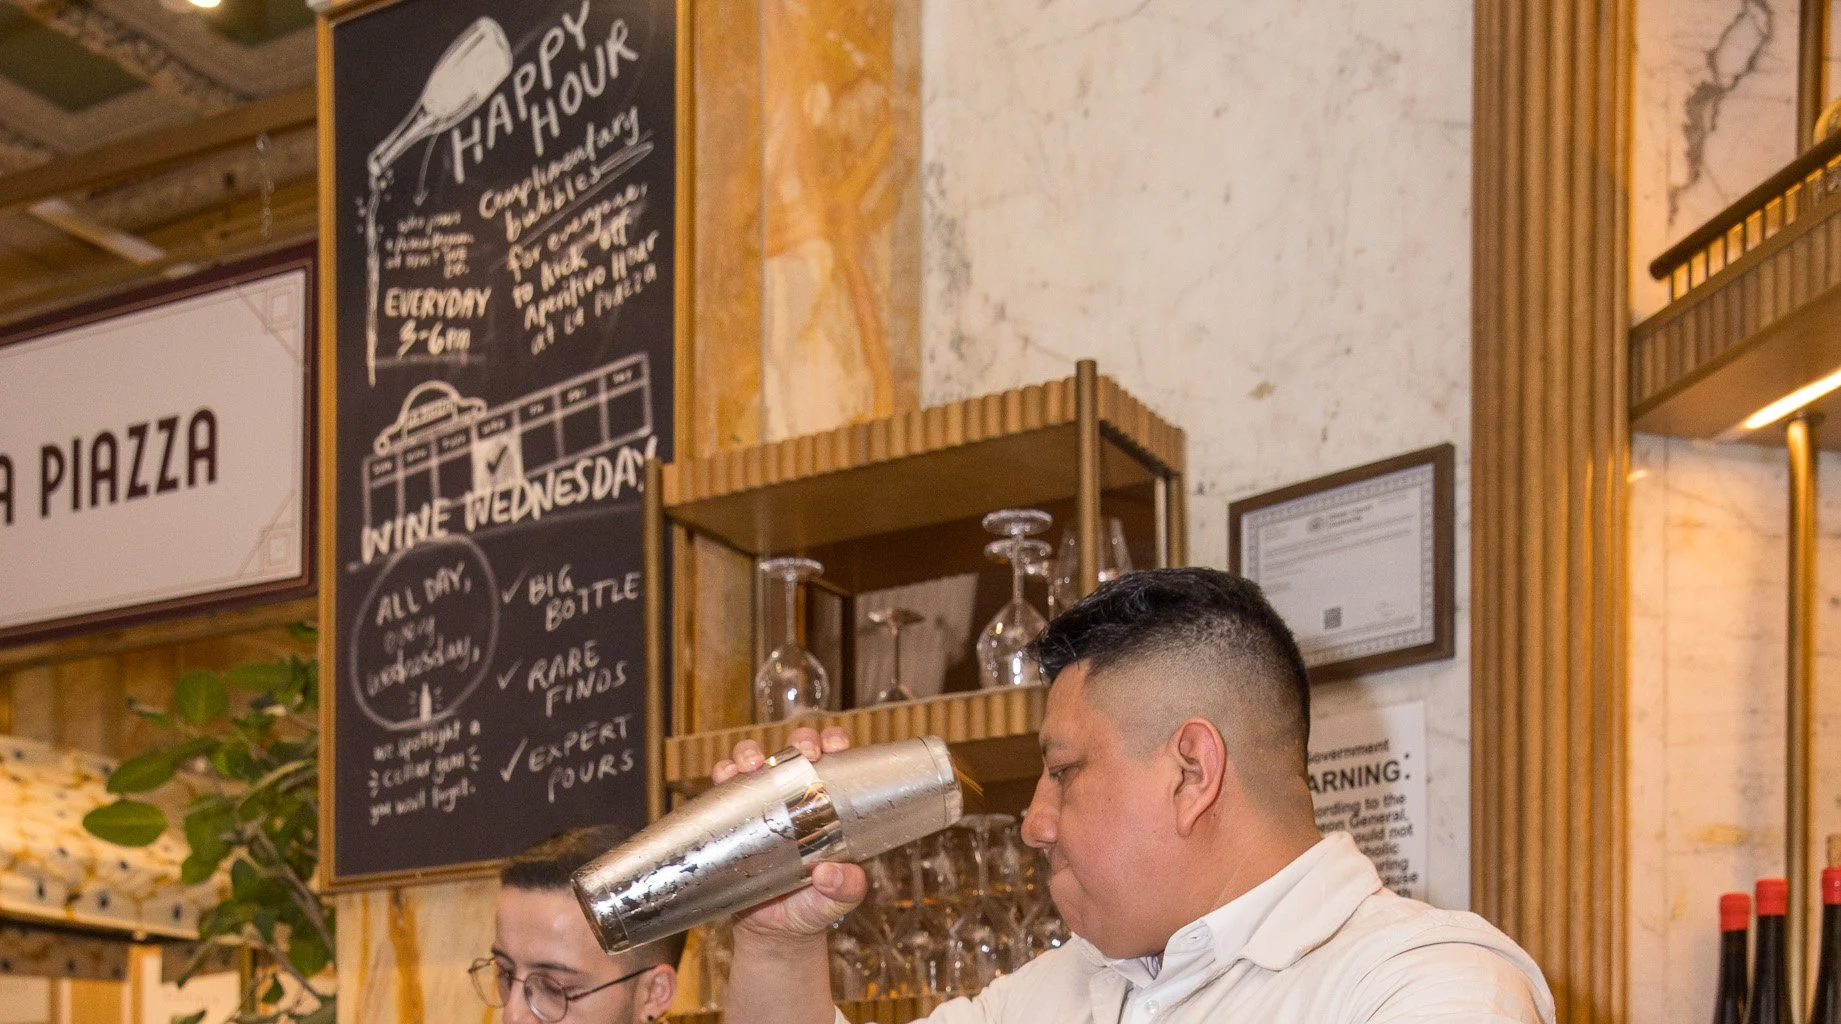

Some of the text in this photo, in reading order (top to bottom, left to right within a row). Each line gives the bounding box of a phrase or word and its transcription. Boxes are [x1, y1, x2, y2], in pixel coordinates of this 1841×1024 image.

[452, 0, 590, 185] HAPPY
[530, 18, 639, 157] HOUR
[507, 243, 543, 283] for
[384, 286, 492, 320] EVERYDAY
[512, 281, 534, 309] to
[40, 407, 218, 519] PIAZZA
[361, 434, 658, 565] WINE WEDNESDAY
[376, 585, 421, 626] ALL
[528, 563, 575, 605] BIG
[545, 571, 642, 632] BOTTLE
[527, 639, 600, 692] RARE
[545, 659, 629, 718] FINDS
[528, 713, 633, 772] EXPERT
[547, 749, 635, 804] POURS
[1309, 752, 1411, 794] ARNING:
[1315, 794, 1407, 818] ording to the
[1354, 823, 1415, 844] ould not
